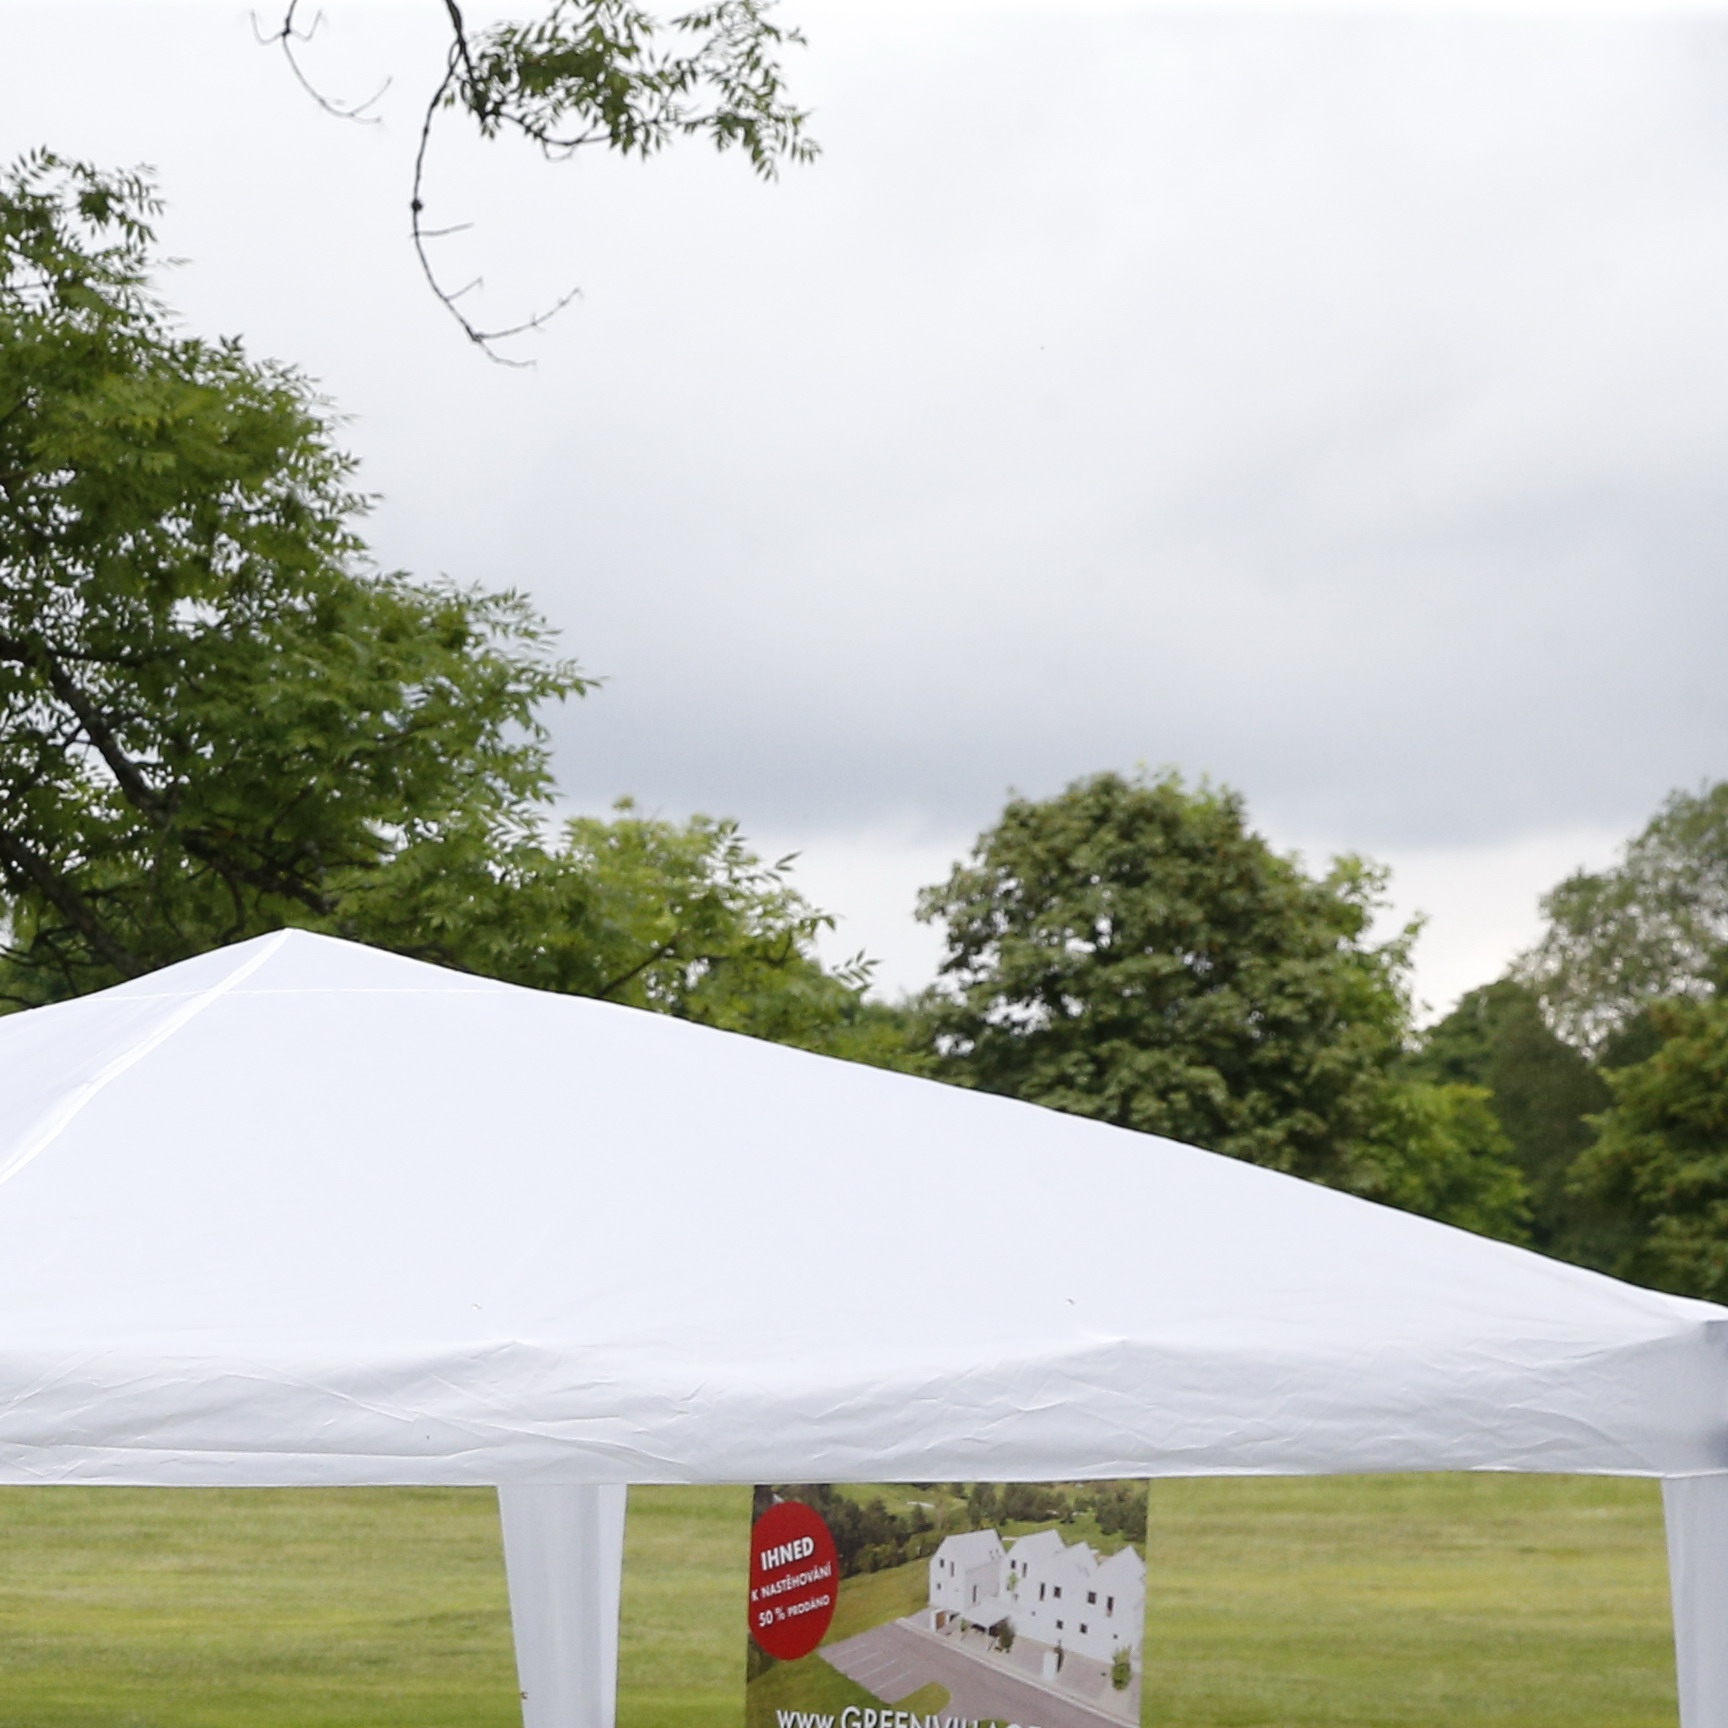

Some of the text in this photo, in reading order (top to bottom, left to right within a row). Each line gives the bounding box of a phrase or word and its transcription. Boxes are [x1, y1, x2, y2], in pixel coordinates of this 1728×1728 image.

[760, 1536, 815, 1571] IHNED
[751, 1589, 759, 1601] K
[759, 1609, 773, 1627] 50
